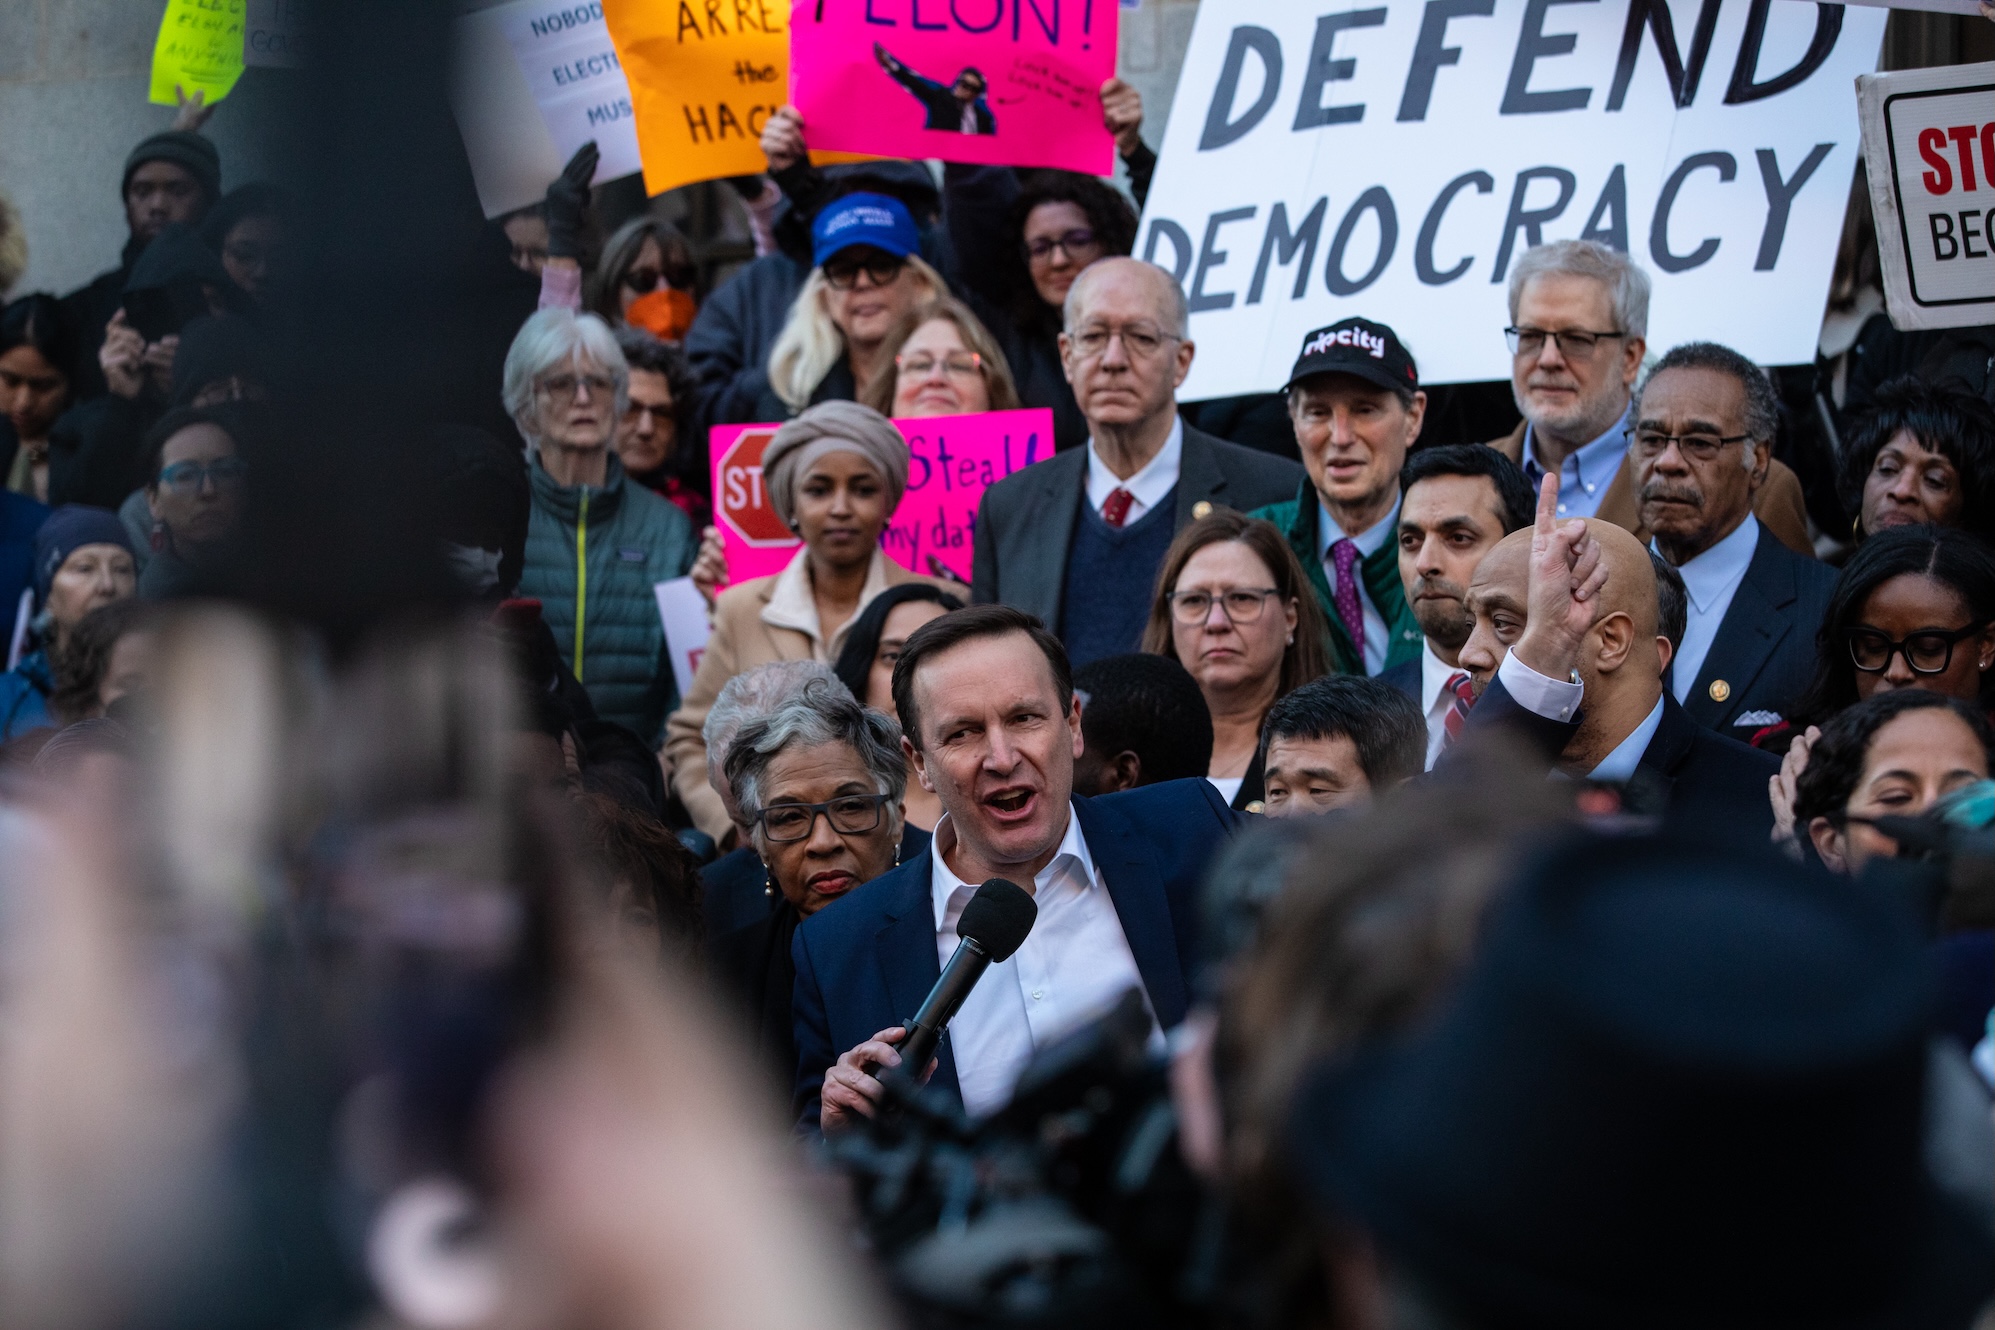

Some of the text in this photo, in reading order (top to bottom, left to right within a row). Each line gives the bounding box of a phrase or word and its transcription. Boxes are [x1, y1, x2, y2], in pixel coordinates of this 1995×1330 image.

[530, 1, 604, 38] NOBOD
[731, 60, 779, 84] the
[1197, 0, 1845, 152] DEFEND
[1142, 142, 1837, 314] DEMOCRACY
[1304, 326, 1385, 358] ripcity
